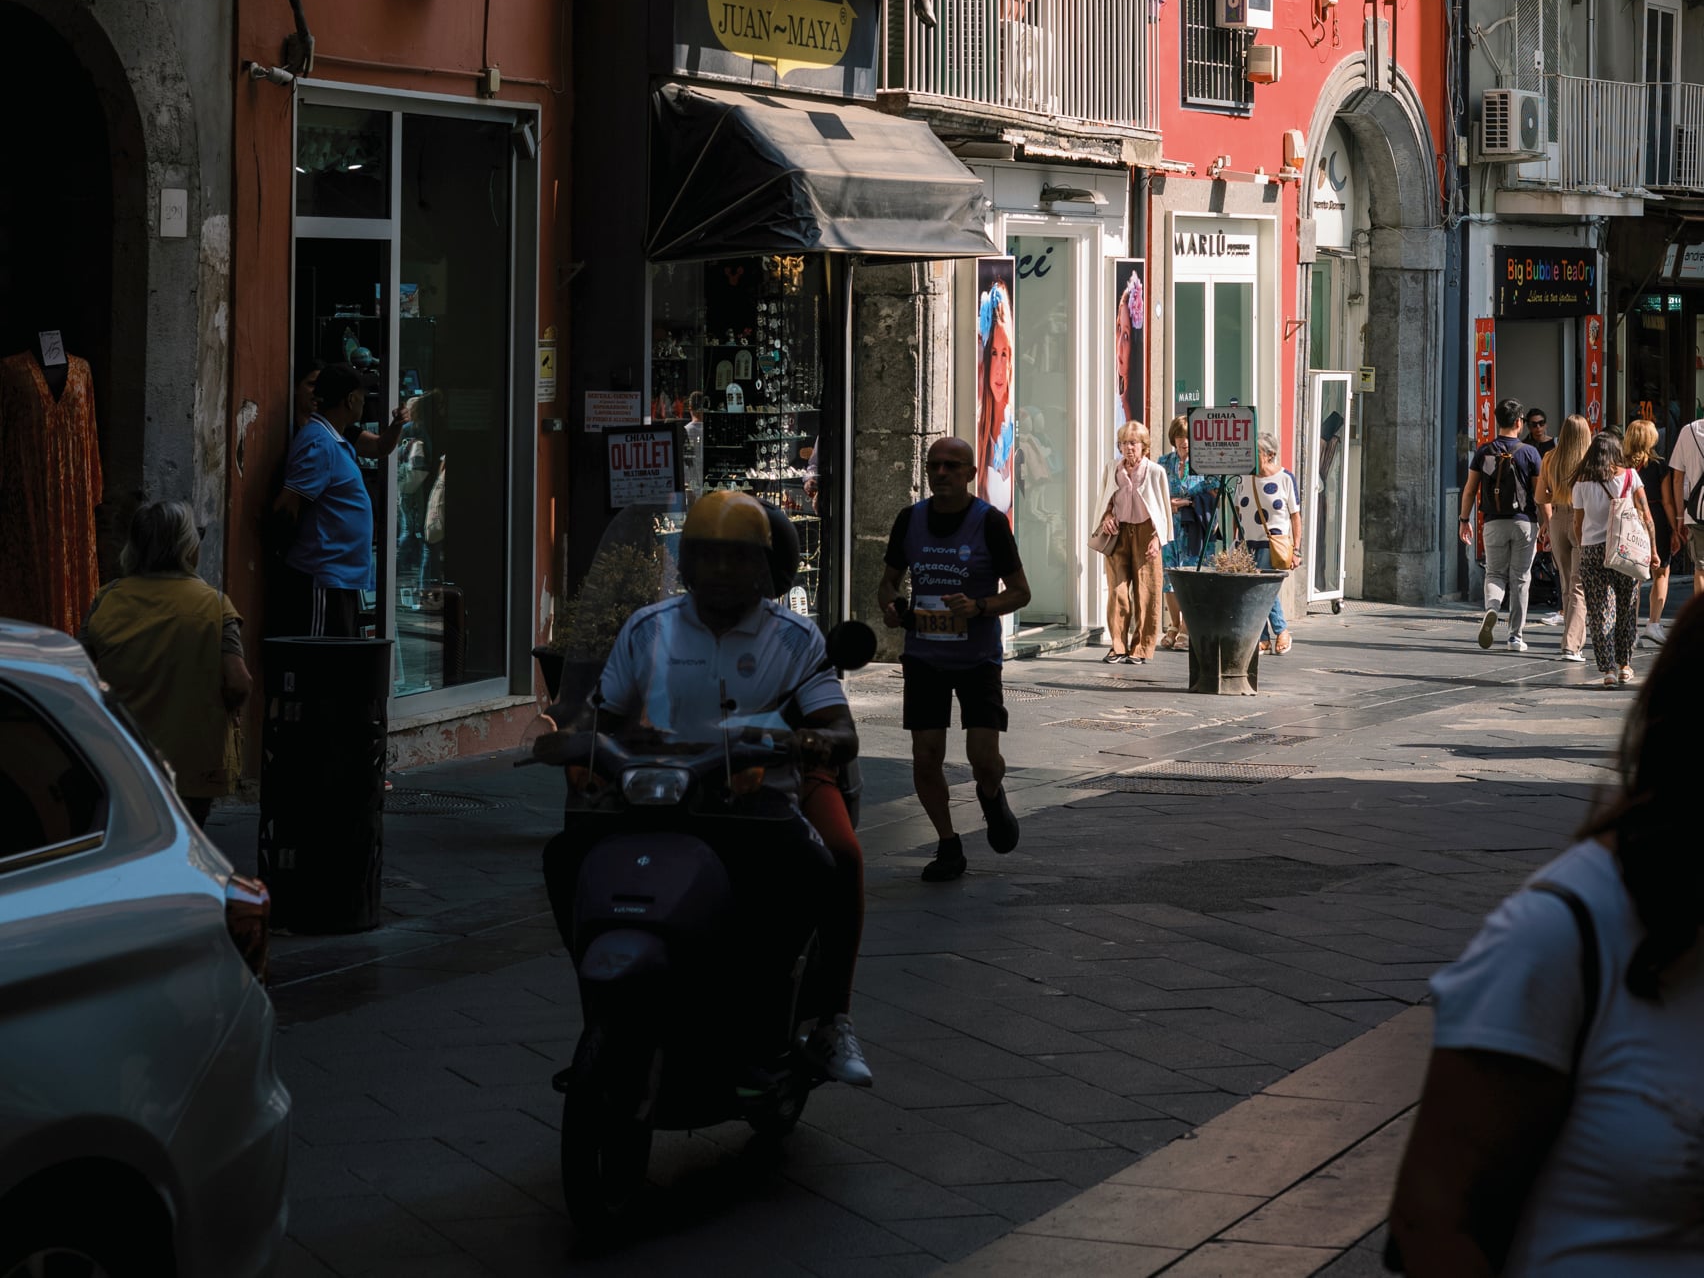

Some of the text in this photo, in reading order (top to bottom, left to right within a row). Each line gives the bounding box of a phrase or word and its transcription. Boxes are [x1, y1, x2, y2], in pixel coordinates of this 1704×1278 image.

[1507, 258, 1595, 286] Big Bubble TeaOry
[625, 434, 655, 442] CHIAIA
[1193, 419, 1251, 441] OUTLET
[611, 441, 671, 470] OUTLET
[623, 469, 660, 477] MULTIBRAND
[922, 546, 957, 555] GIVOVA
[913, 562, 970, 578] Caracciolo
[918, 574, 962, 586] Runners
[922, 615, 956, 631] 1831
